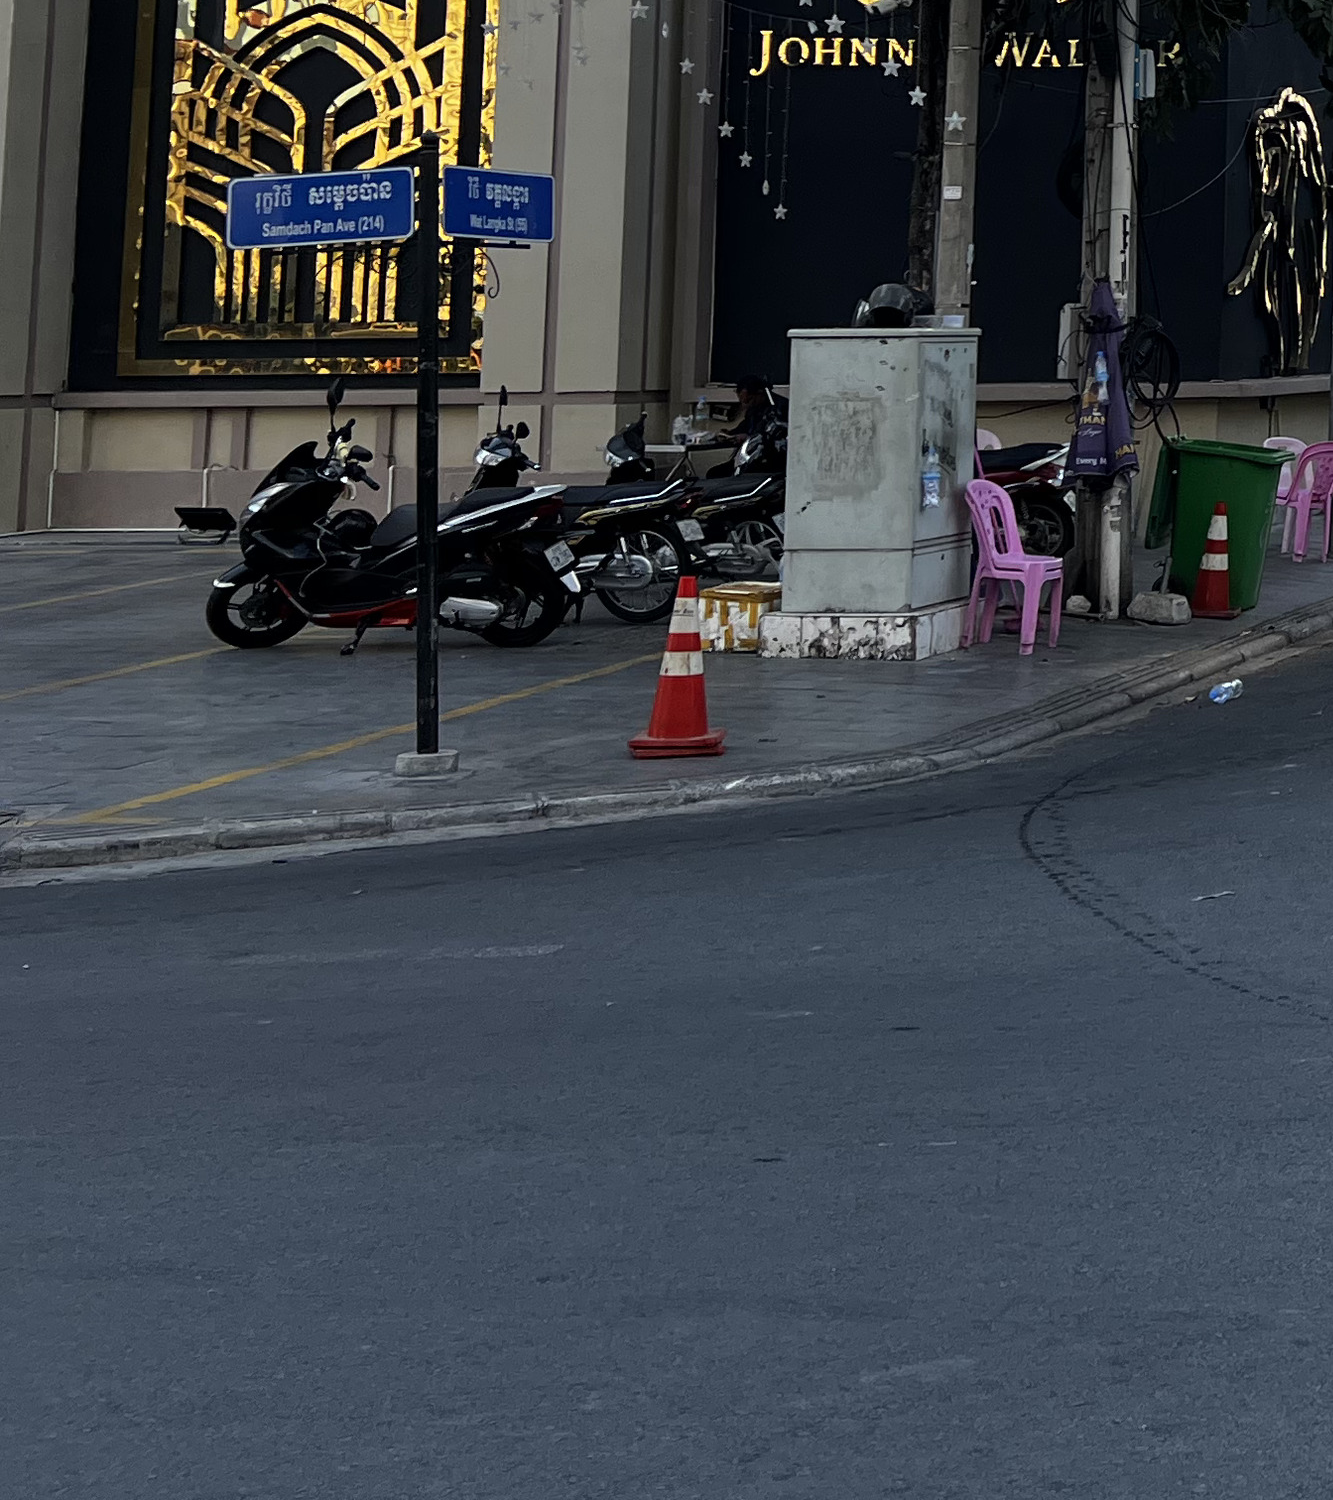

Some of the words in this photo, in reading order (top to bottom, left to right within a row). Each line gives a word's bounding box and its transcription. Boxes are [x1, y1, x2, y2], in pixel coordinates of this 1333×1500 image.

[748, 29, 915, 77] JOHNN
[995, 31, 1182, 68] WALR
[261, 222, 312, 238] Samdach
[313, 219, 334, 234] Pan
[336, 218, 356, 233] Ave
[358, 215, 385, 234] (214)
